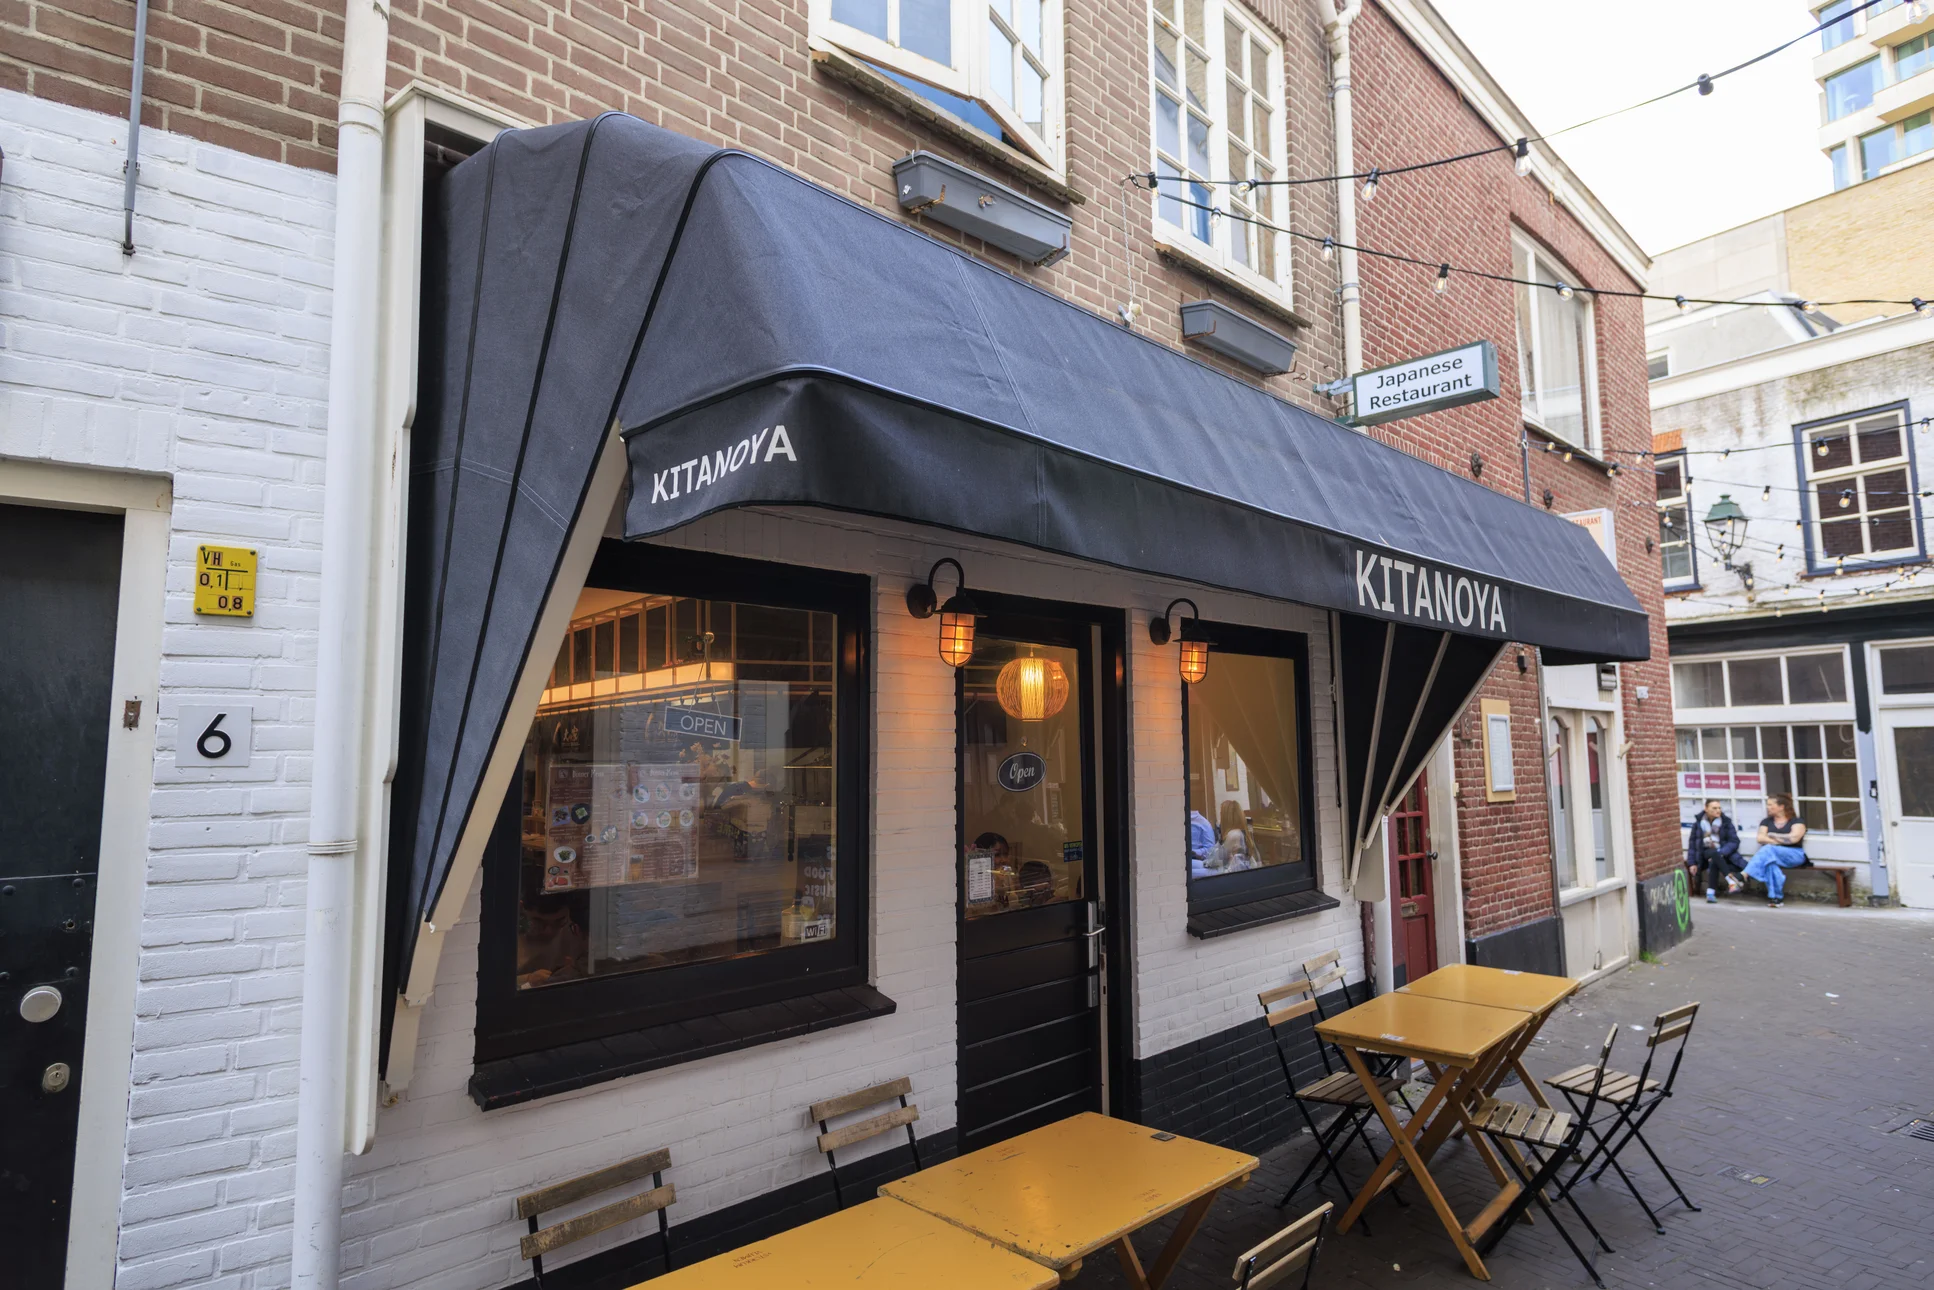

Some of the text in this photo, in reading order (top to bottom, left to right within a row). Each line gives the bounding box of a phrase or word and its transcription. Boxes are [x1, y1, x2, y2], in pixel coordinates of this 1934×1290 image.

[1377, 358, 1463, 389] Japanese
[1370, 374, 1473, 410] Restaurant
[651, 425, 797, 504] KITANOYA
[202, 551, 221, 567] VH
[1356, 550, 1507, 633] KITANOYA
[196, 712, 232, 759] 6
[680, 715, 727, 736] OPEN
[1009, 762, 1035, 784] Open
